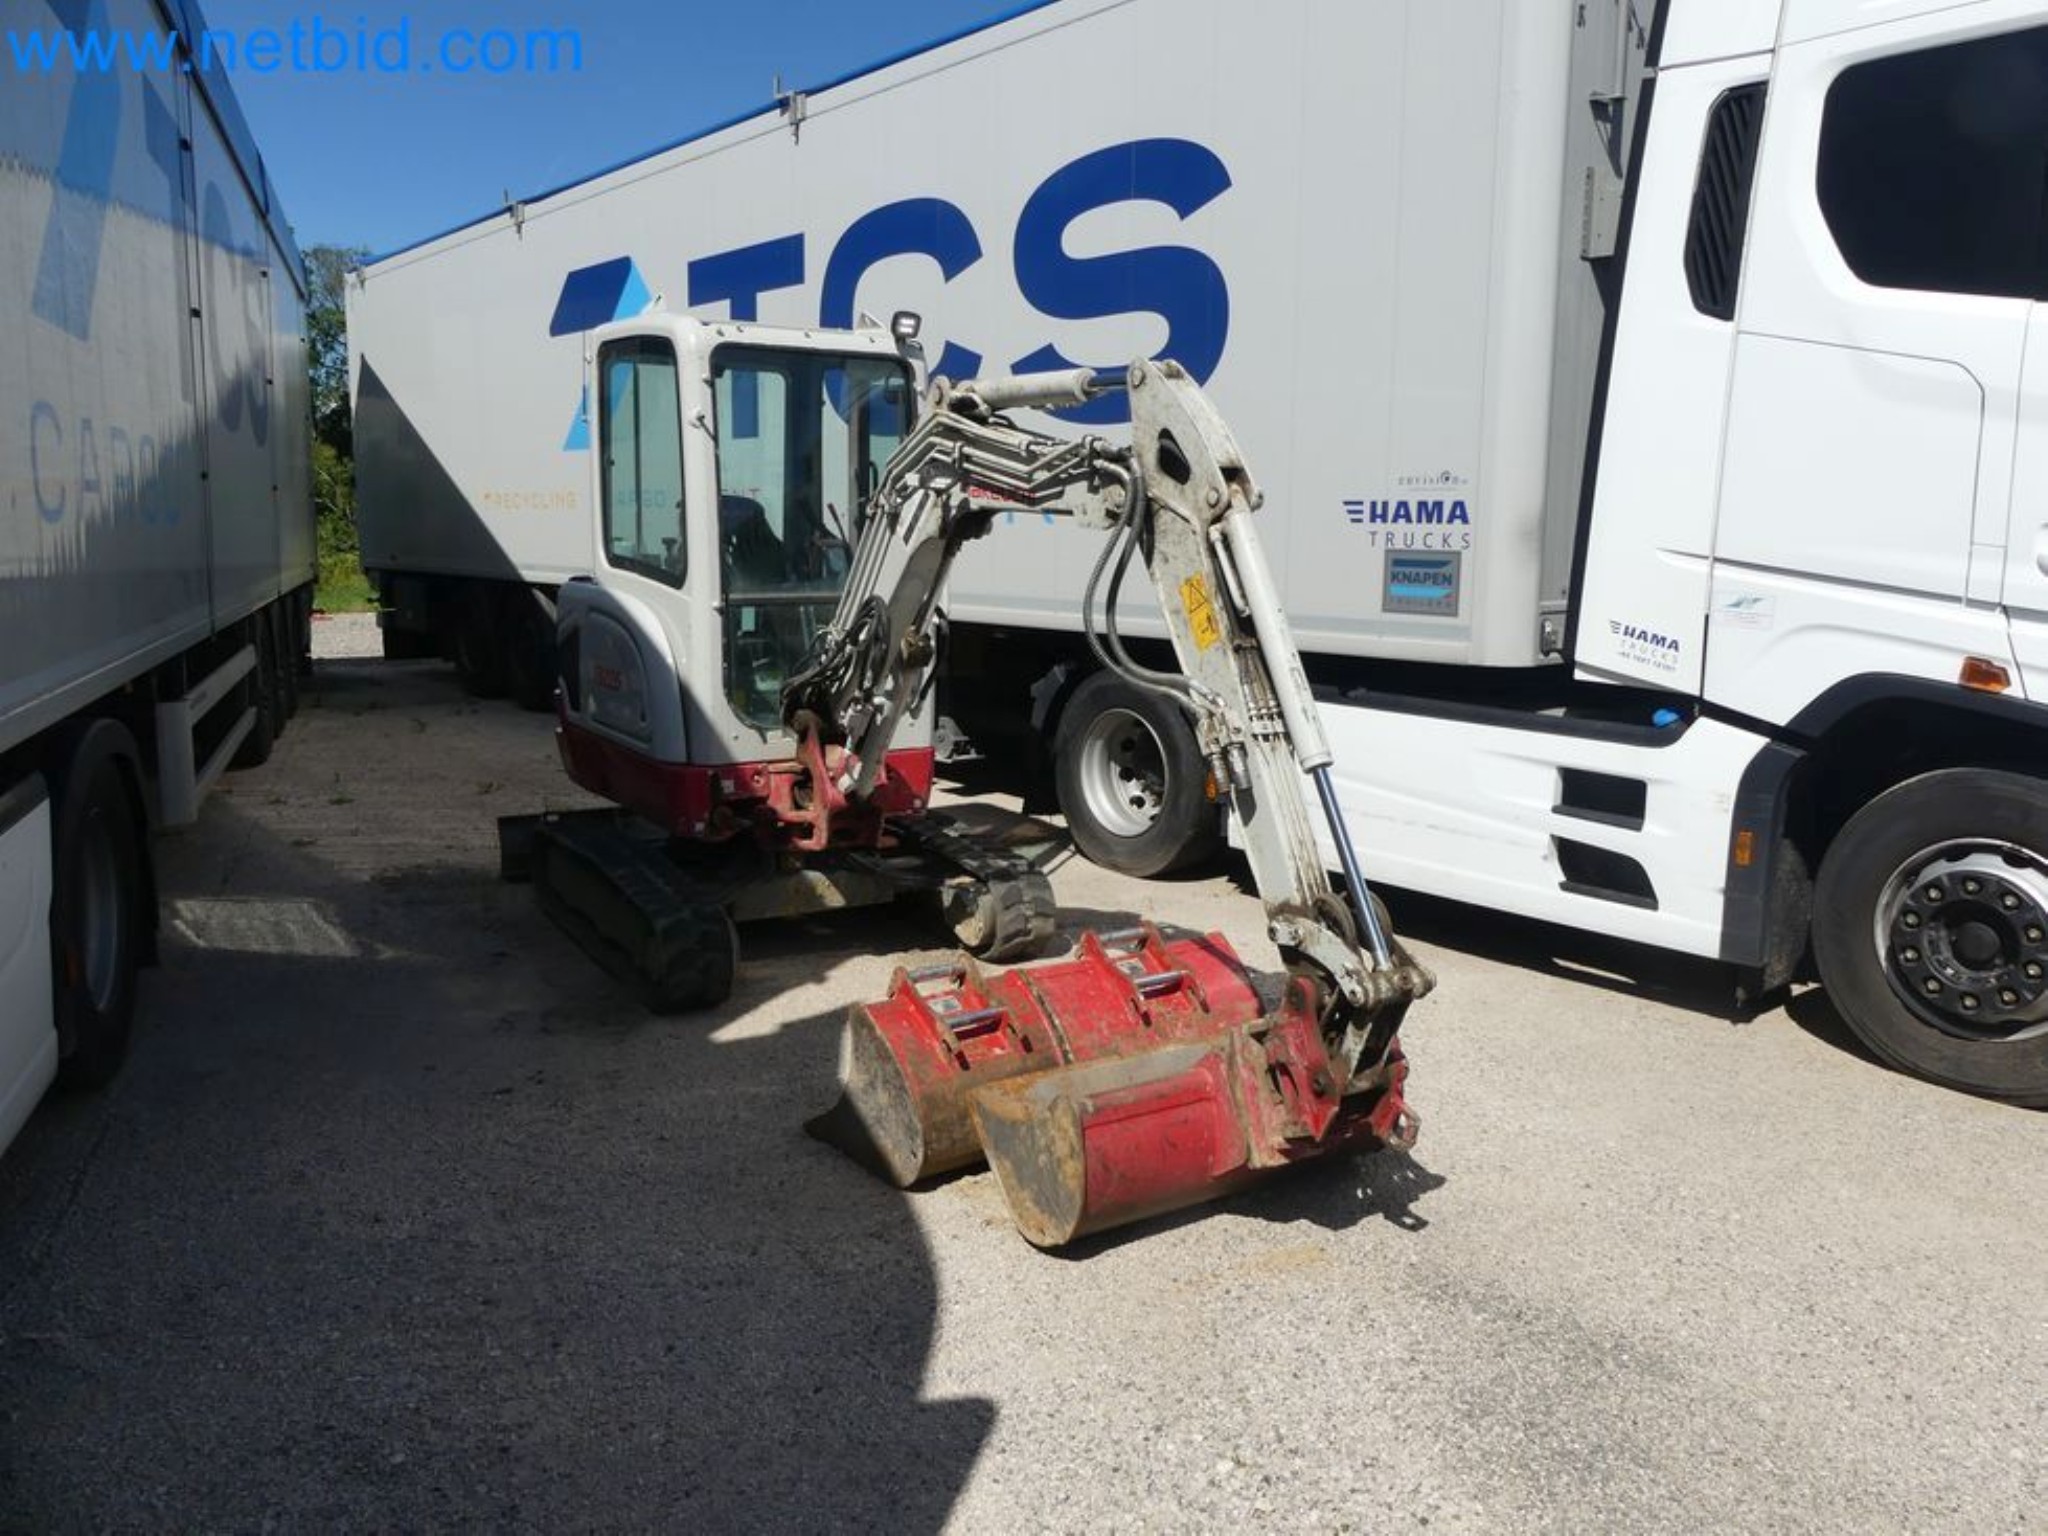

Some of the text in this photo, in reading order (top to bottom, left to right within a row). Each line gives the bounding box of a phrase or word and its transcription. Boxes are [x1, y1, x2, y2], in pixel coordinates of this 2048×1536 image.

[1369, 500, 1470, 525] HAMA
[1369, 531, 1471, 549] TRUCKS
[1390, 570, 1453, 586] KNAPEN
[1623, 625, 1680, 653] HAMA
